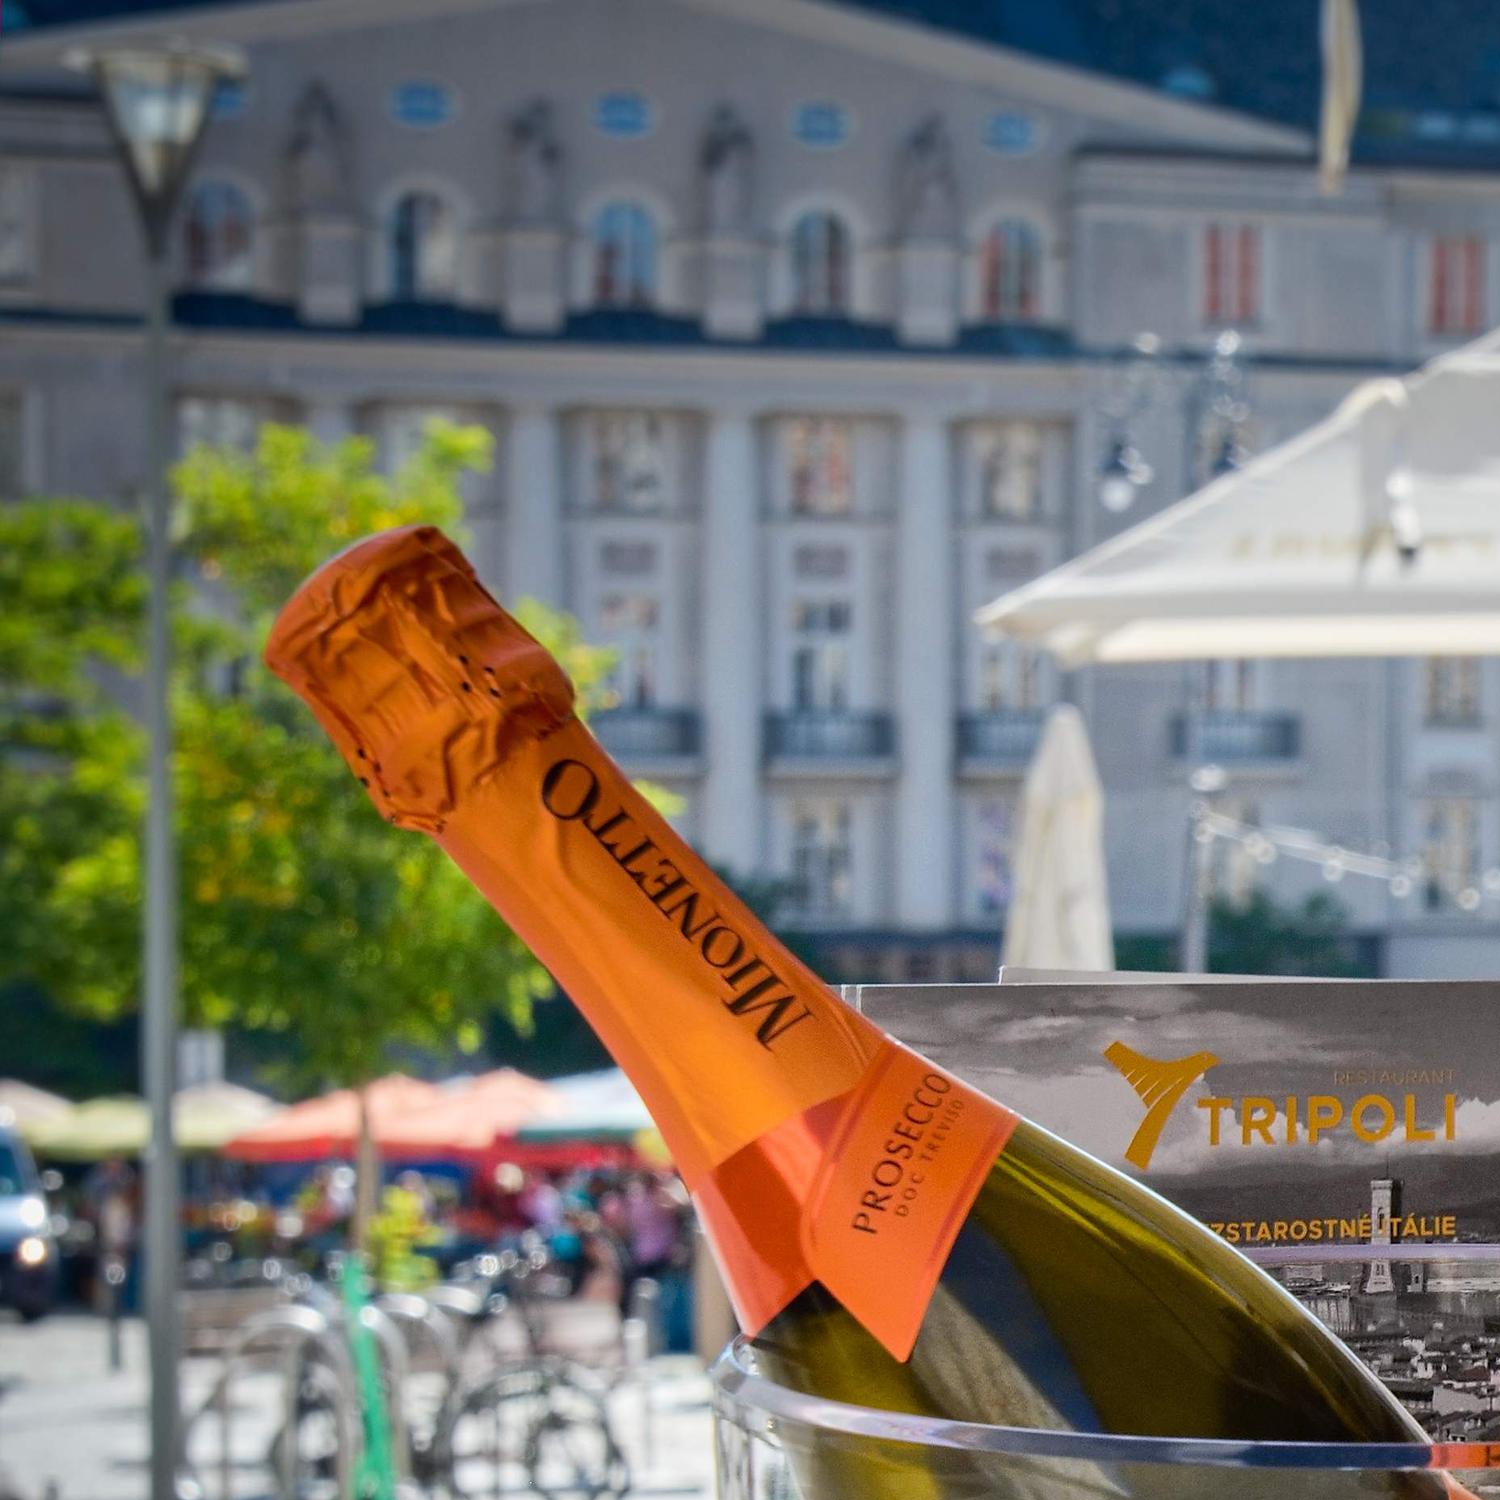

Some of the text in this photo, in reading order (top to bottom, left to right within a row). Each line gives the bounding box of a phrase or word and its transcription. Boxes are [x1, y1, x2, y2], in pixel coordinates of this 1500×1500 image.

[542, 758, 817, 1052] MIONETTO
[1197, 1093, 1458, 1147] TRIPOLI
[1333, 1068, 1457, 1086] RESTAURANT
[852, 1072, 951, 1234] PROSECCO
[894, 1099, 964, 1217] DOC TREVISO
[1204, 1213, 1372, 1243] ZSTAROSTNÉ
